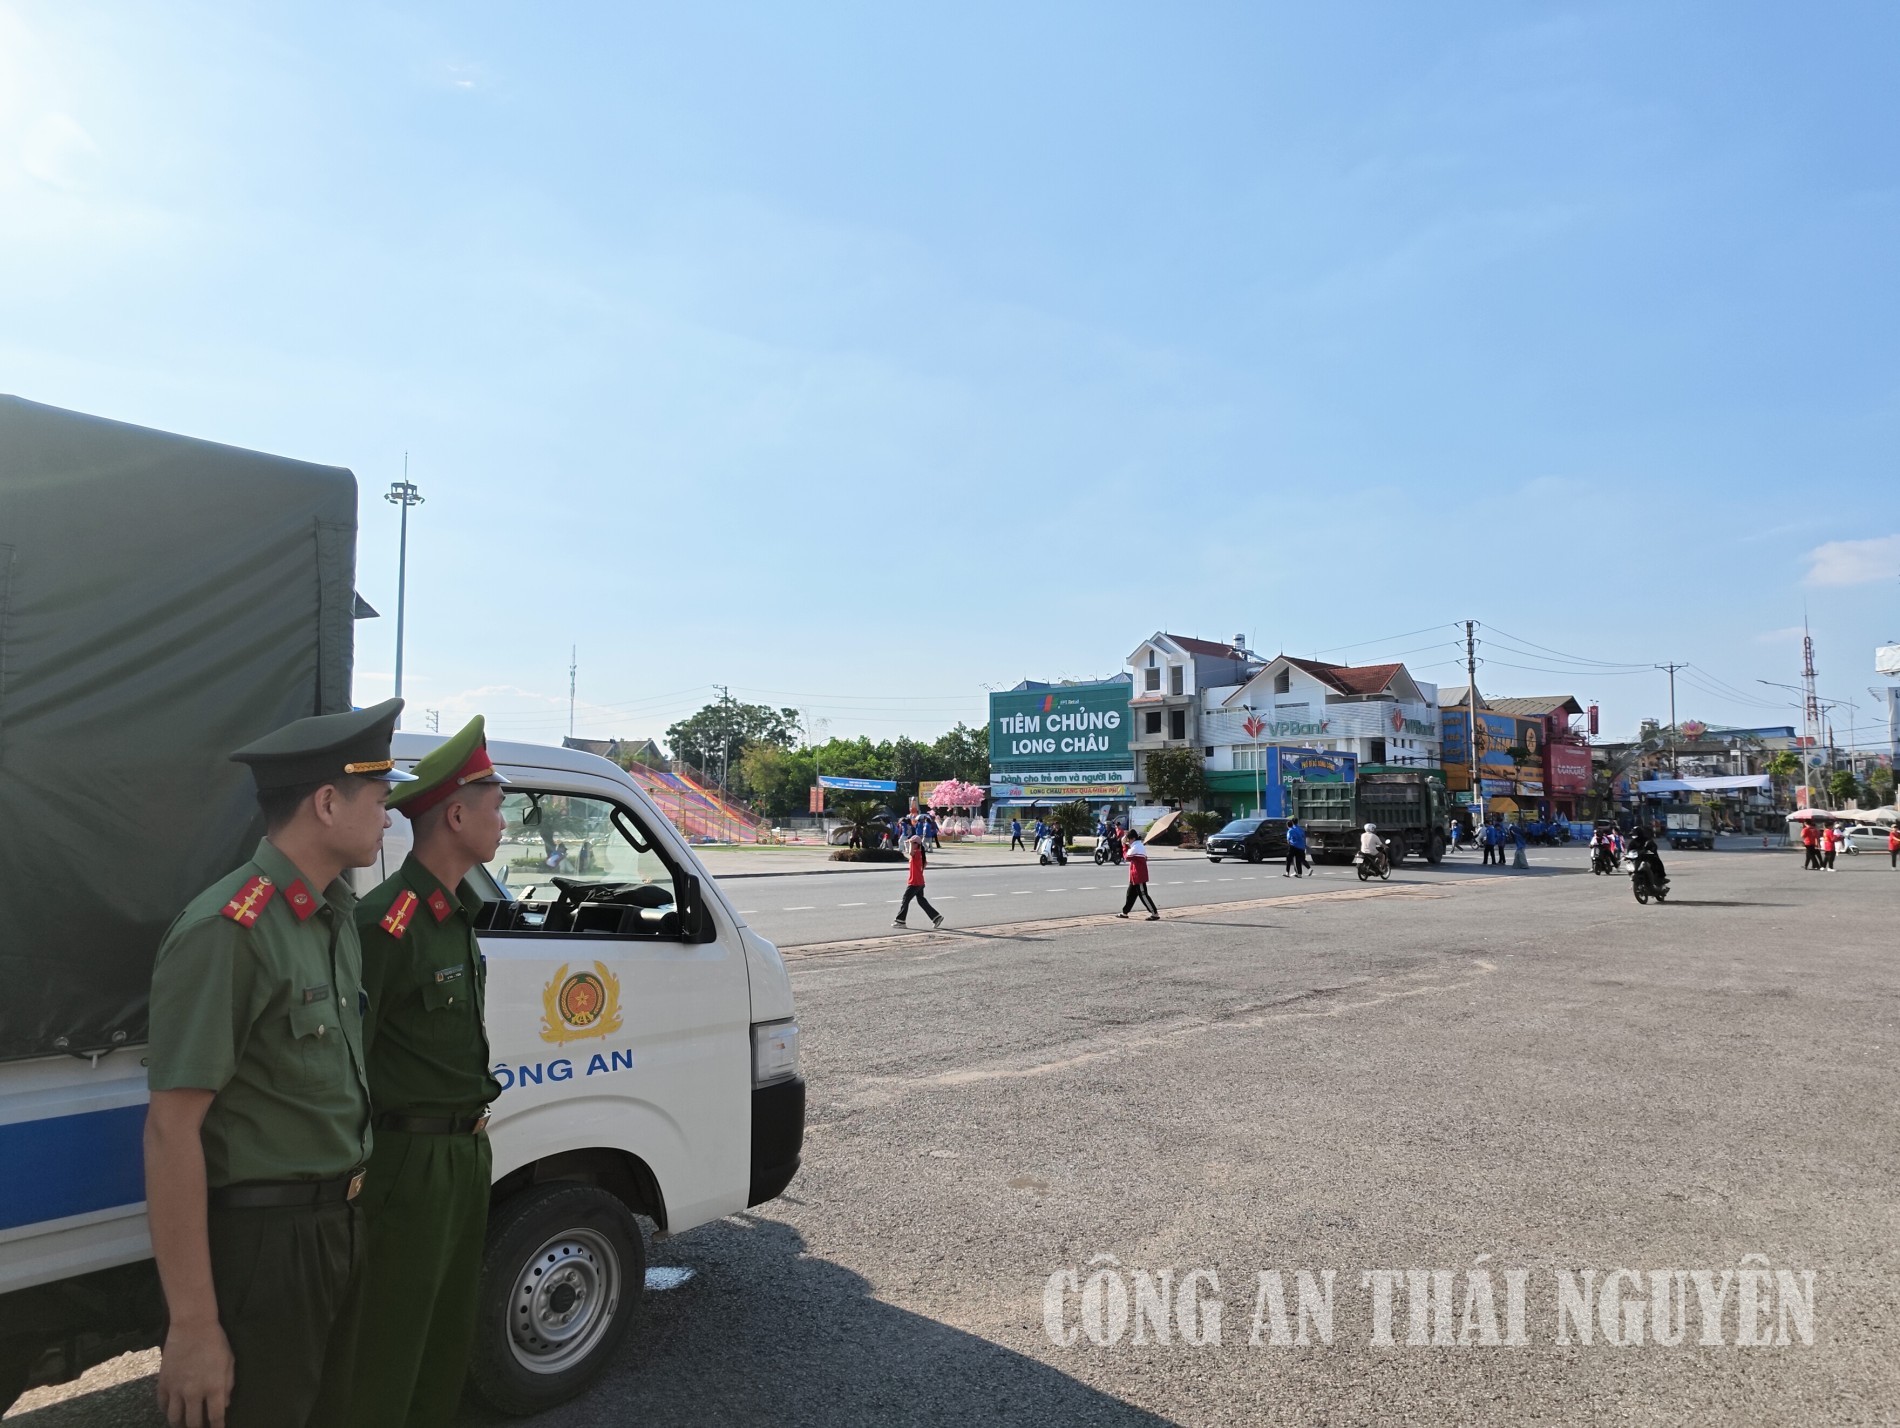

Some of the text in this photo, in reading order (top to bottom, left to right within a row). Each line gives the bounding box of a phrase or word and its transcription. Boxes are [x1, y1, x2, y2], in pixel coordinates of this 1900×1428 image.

[1000, 706, 1120, 734] TIÊM CHỦNG
[1268, 718, 1330, 737] VPBank
[1404, 717, 1436, 736] VPBank
[1012, 733, 1109, 755] LONG CHÂU
[1001, 774, 1022, 783] Dành
[1024, 774, 1039, 782] cho
[1069, 773, 1080, 781] và
[1082, 772, 1107, 784] người
[1108, 772, 1123, 781] lớn
[491, 1049, 633, 1091] ÔNG AN
